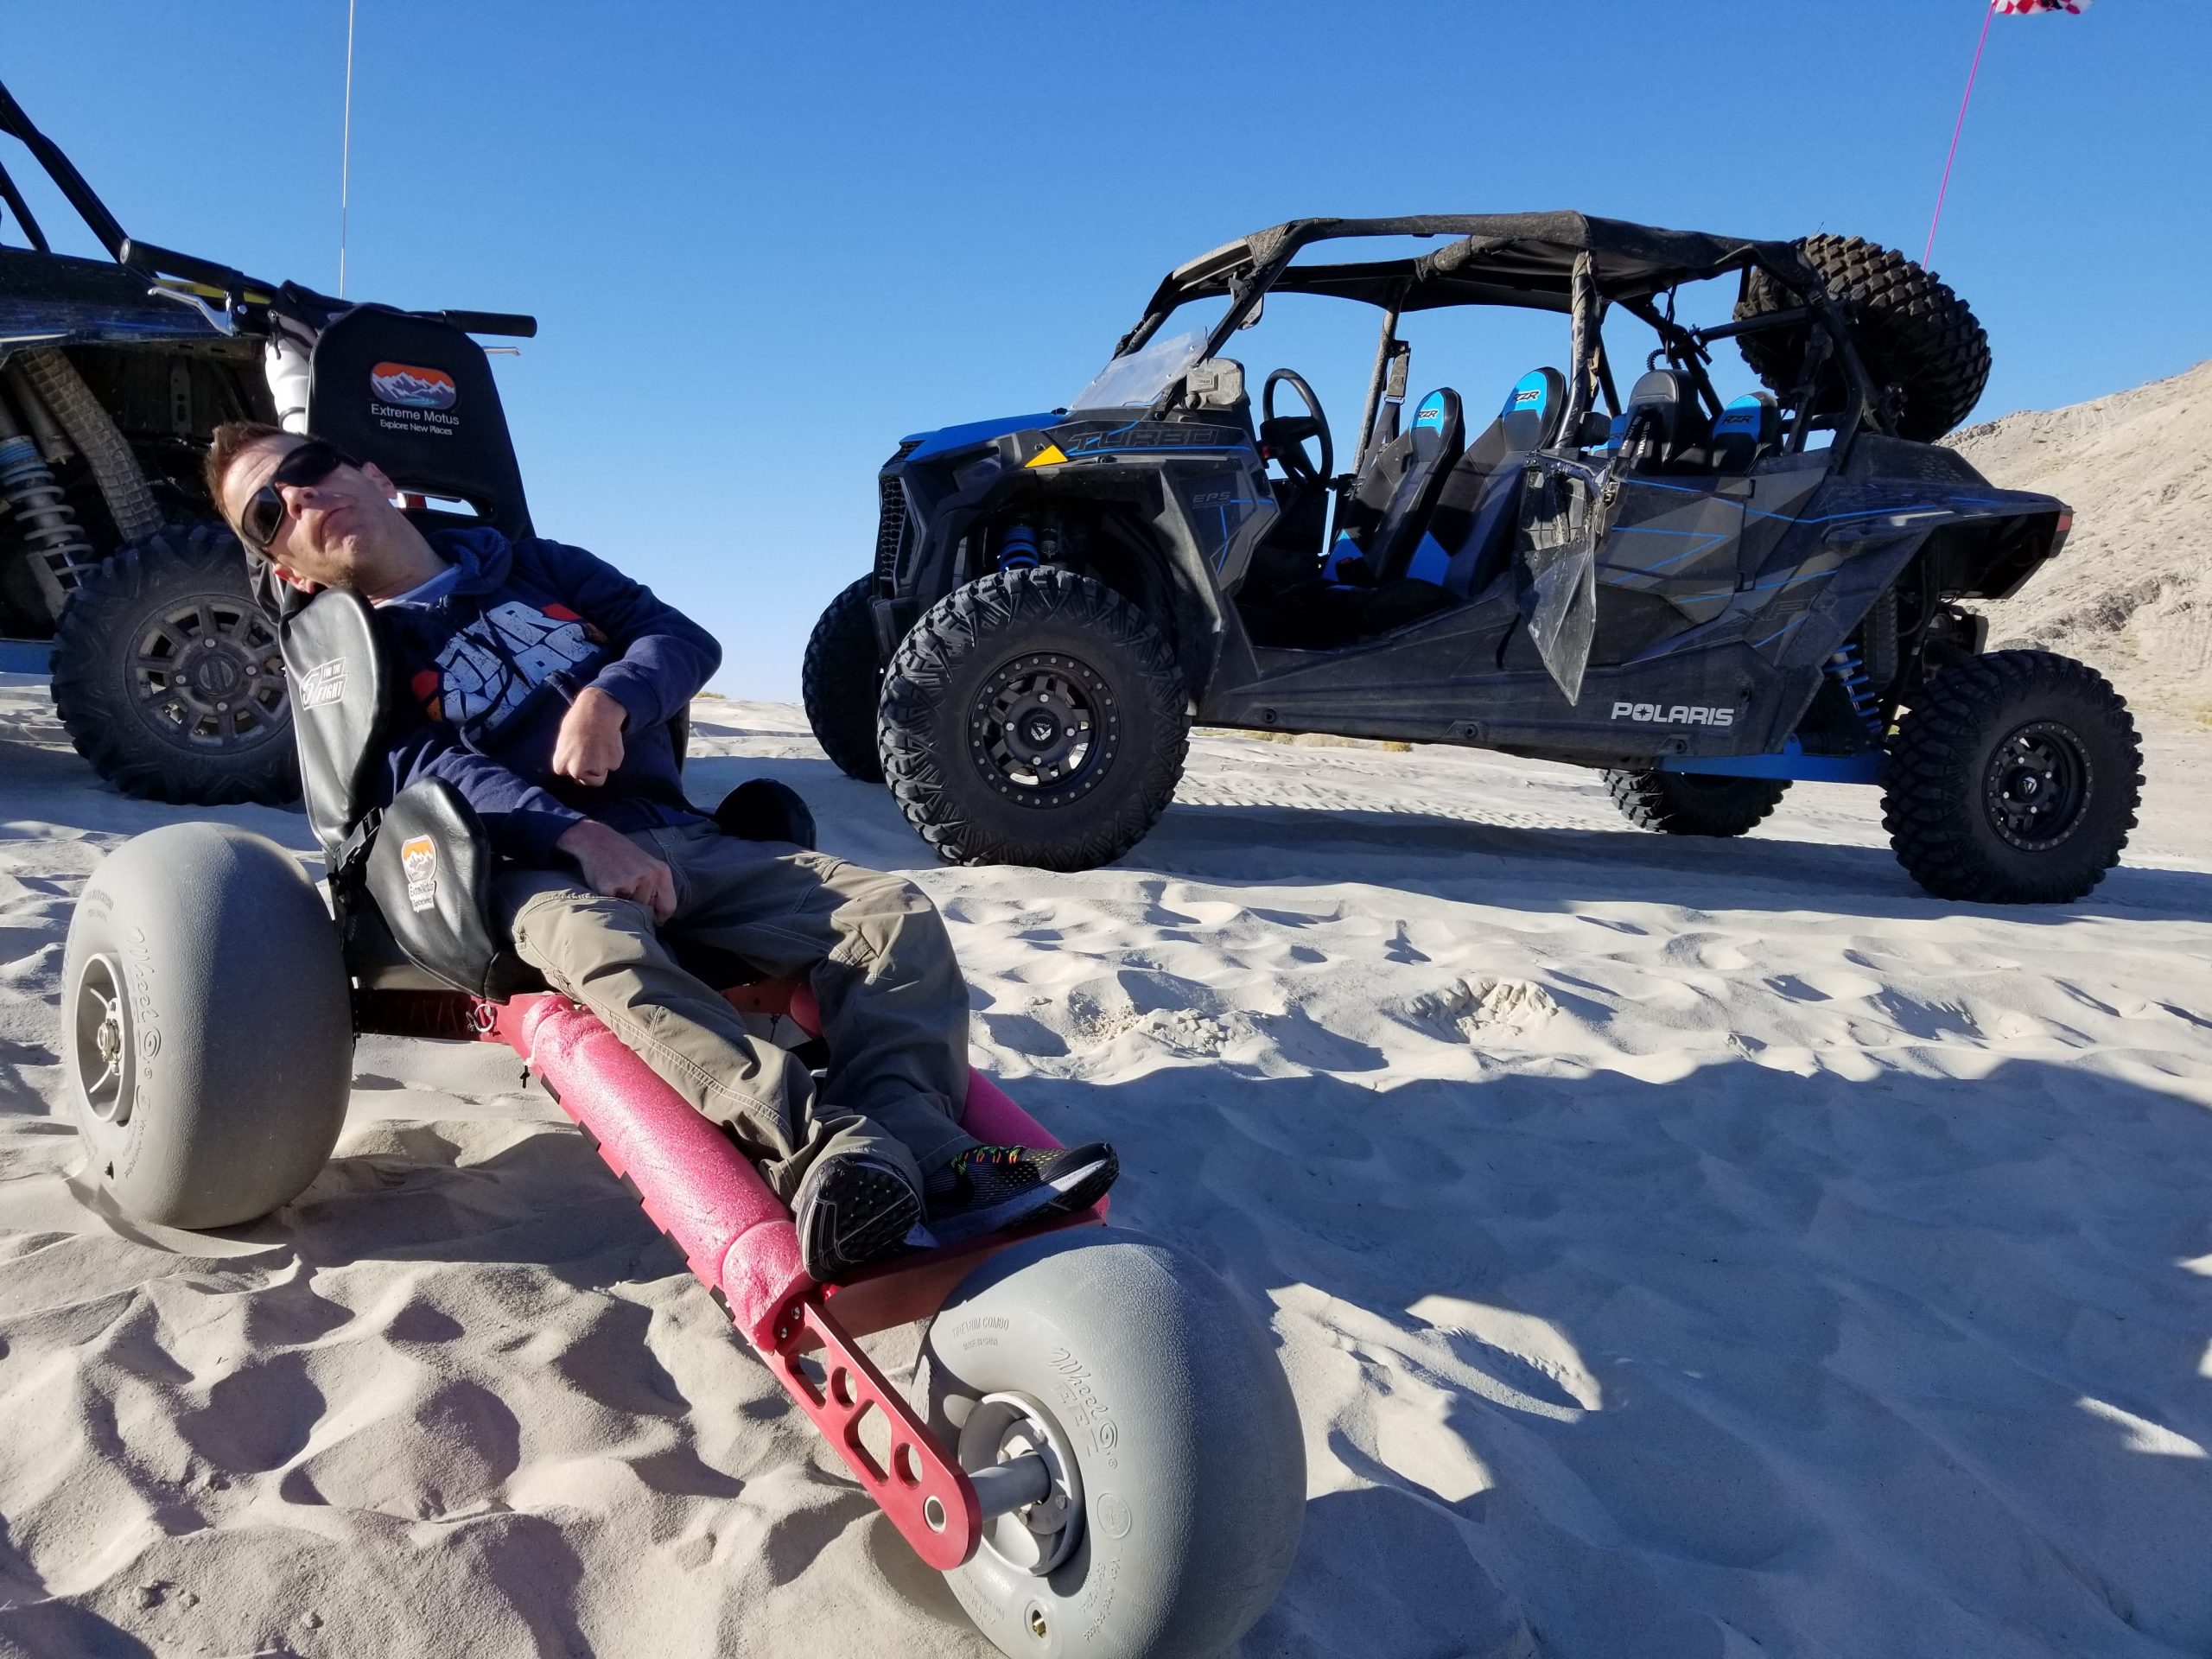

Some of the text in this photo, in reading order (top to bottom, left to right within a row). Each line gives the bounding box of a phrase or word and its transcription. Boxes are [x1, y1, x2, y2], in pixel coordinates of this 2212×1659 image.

[371, 403, 460, 425] Extreme Motus
[380, 419, 453, 435] Explore New Places
[1068, 429, 1219, 451] TURBO
[1192, 491, 1231, 504] EPS
[315, 680, 344, 702] FIGHT
[1611, 702, 1735, 726] POLARIS
